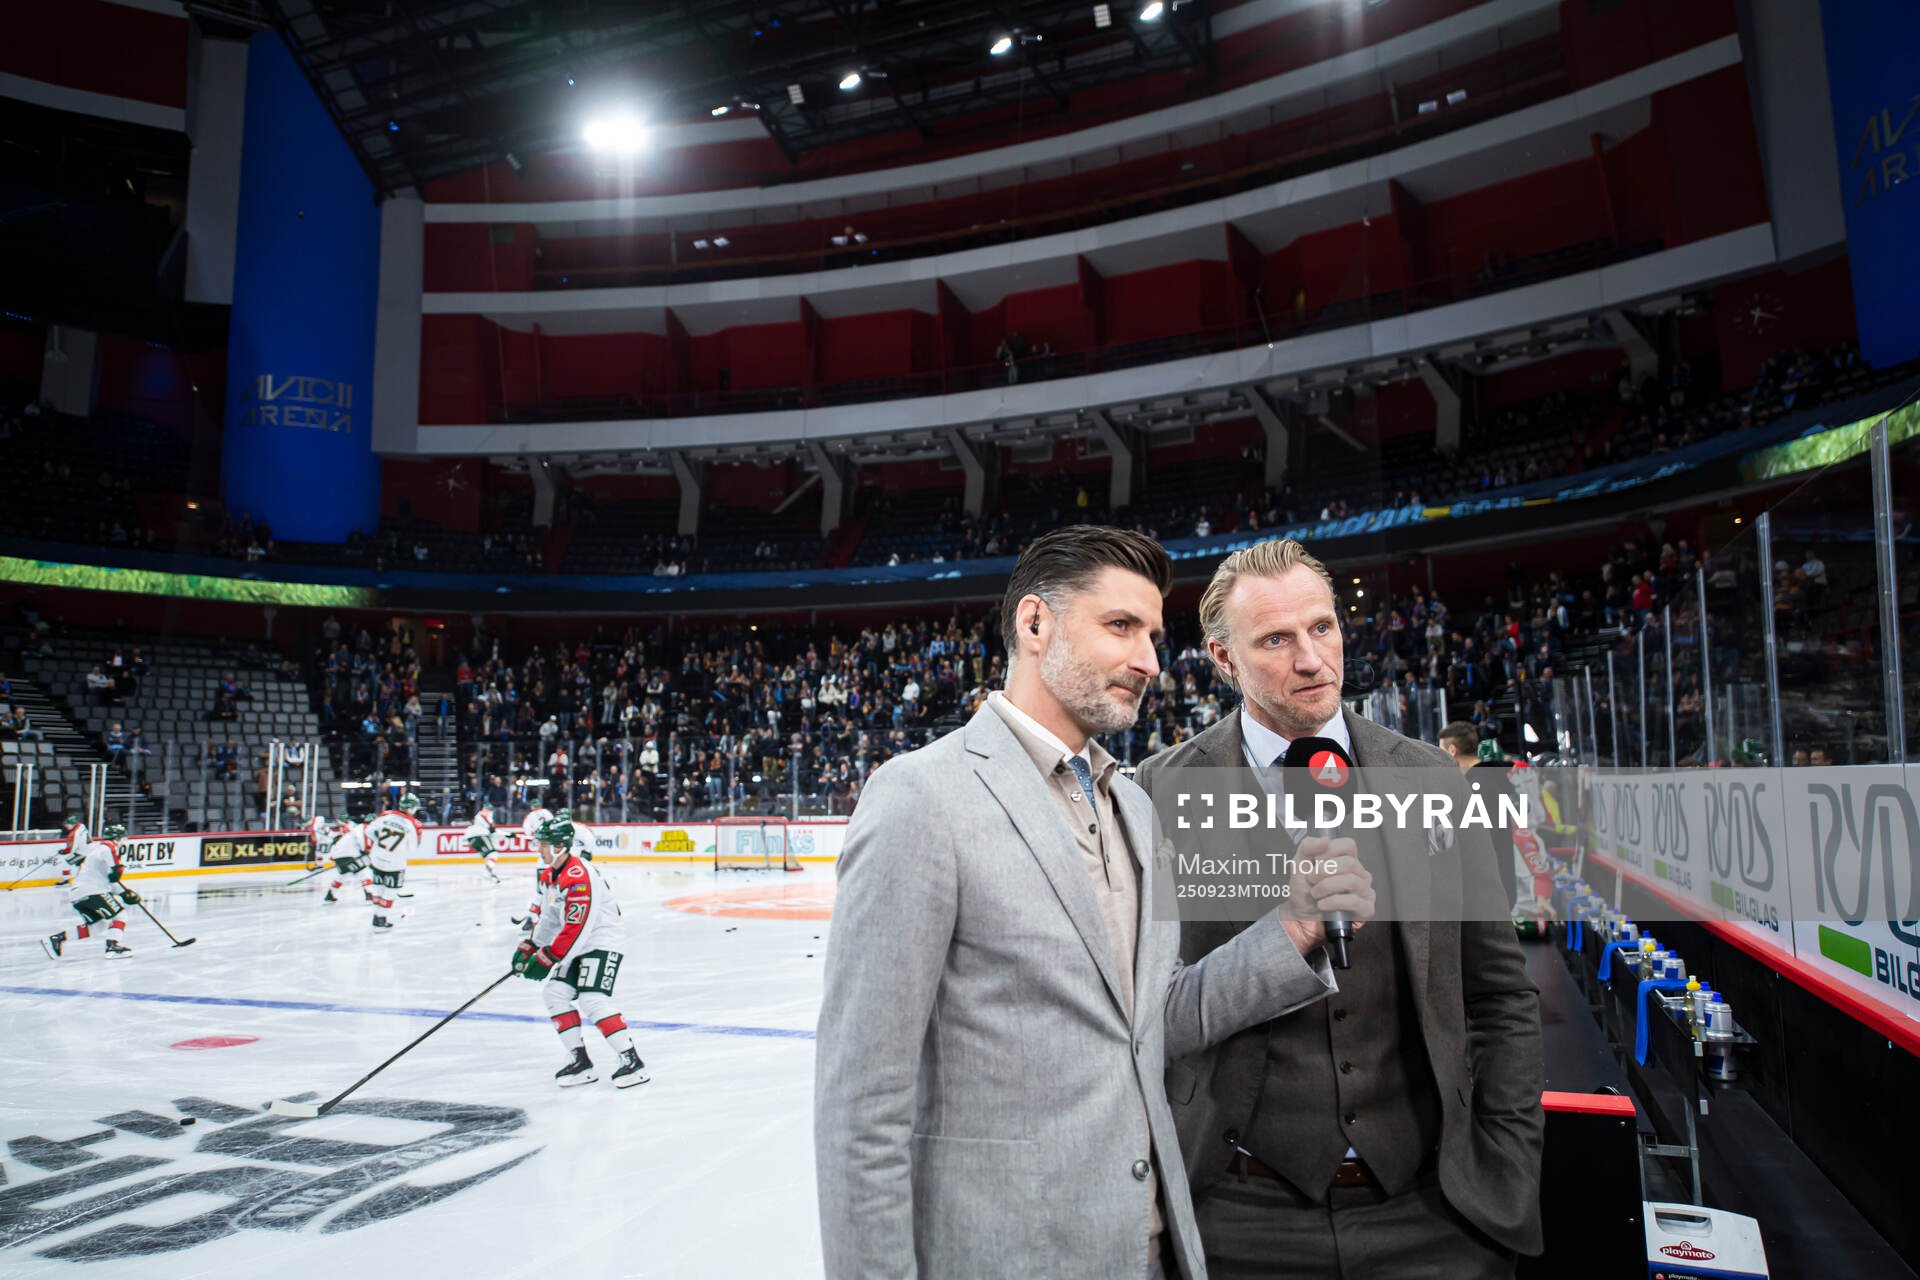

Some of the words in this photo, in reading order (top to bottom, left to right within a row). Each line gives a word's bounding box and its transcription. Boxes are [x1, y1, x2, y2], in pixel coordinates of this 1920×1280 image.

[240, 373, 352, 409] AVICII
[240, 404, 352, 433] ARENA
[1316, 751, 1342, 783] 4
[156, 842, 175, 860] BY
[378, 828, 405, 852] 27
[1703, 782, 1774, 892] RYDS
[207, 844, 231, 860] XL
[1807, 782, 1920, 949] RYD
[566, 903, 587, 923] 21
[1734, 891, 1779, 932] BILGLAS
[1661, 1247, 1713, 1260] playmate
